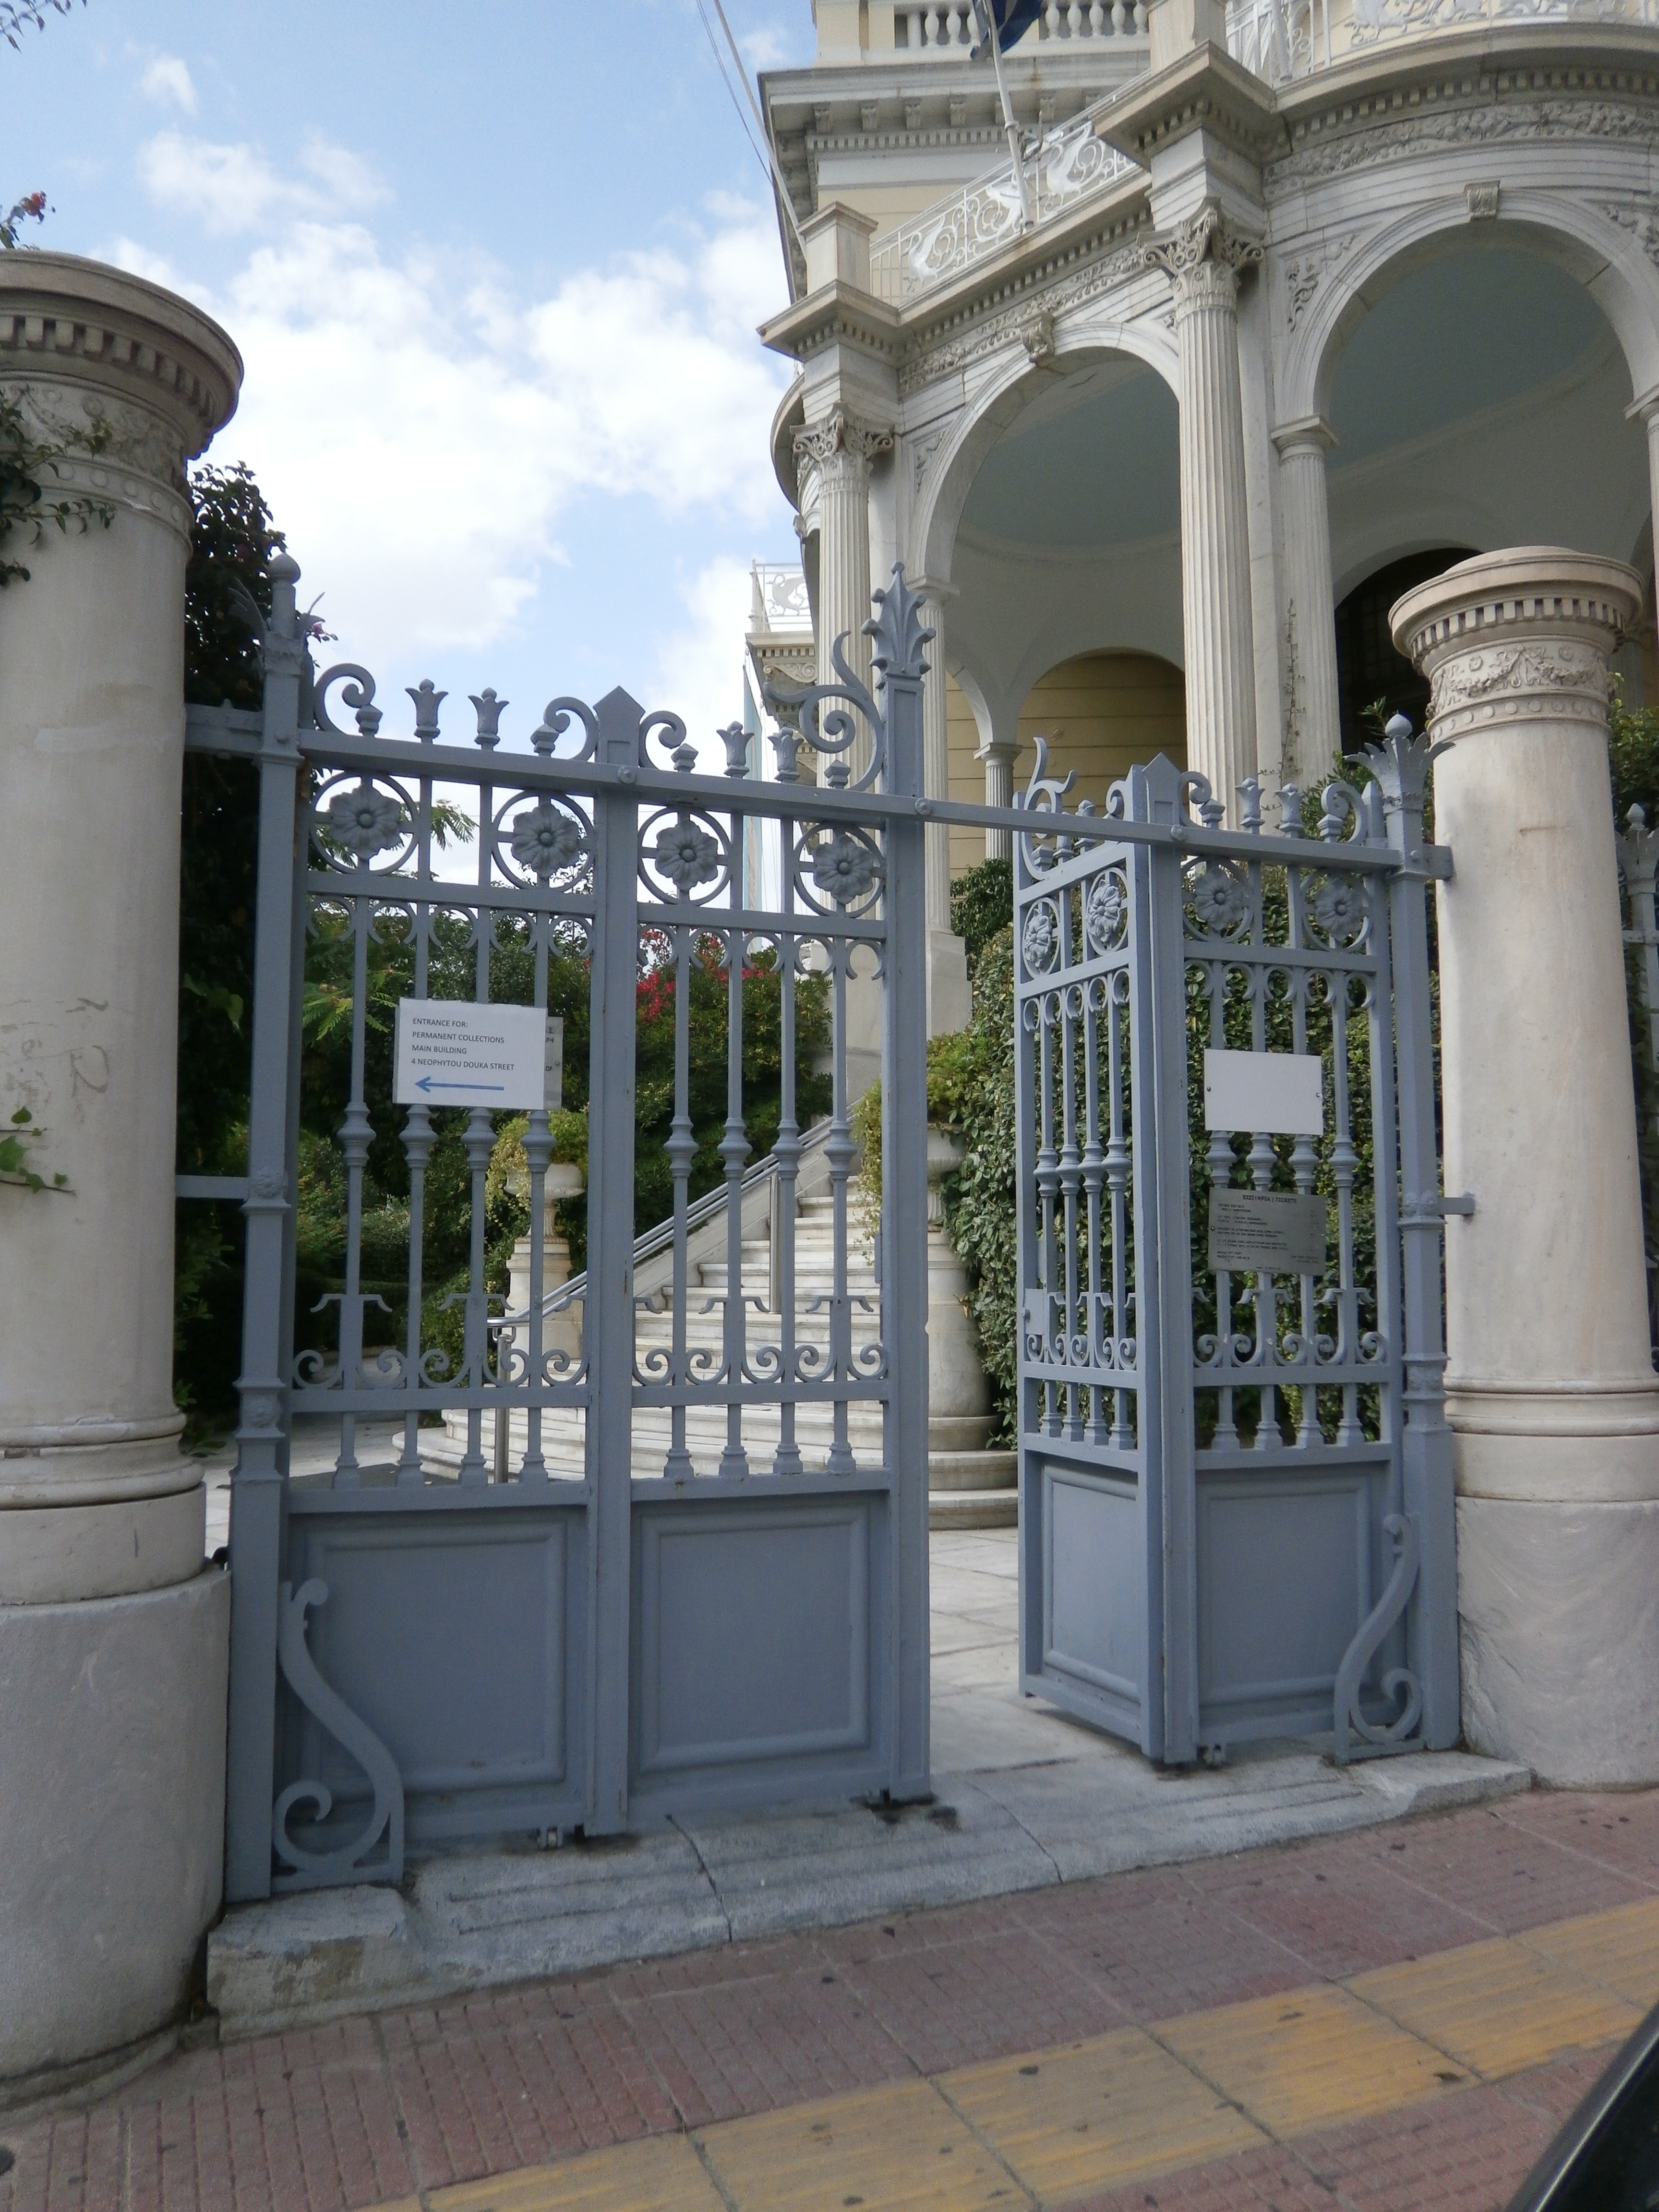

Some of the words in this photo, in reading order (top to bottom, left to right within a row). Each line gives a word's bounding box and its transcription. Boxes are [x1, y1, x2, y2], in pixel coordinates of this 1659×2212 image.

[413, 1018, 450, 1026] ENTRANCE
[412, 1031, 456, 1040] PERMANENT
[458, 1034, 505, 1044] COLLECTIONS
[418, 1058, 461, 1067] NEOPHYTOU
